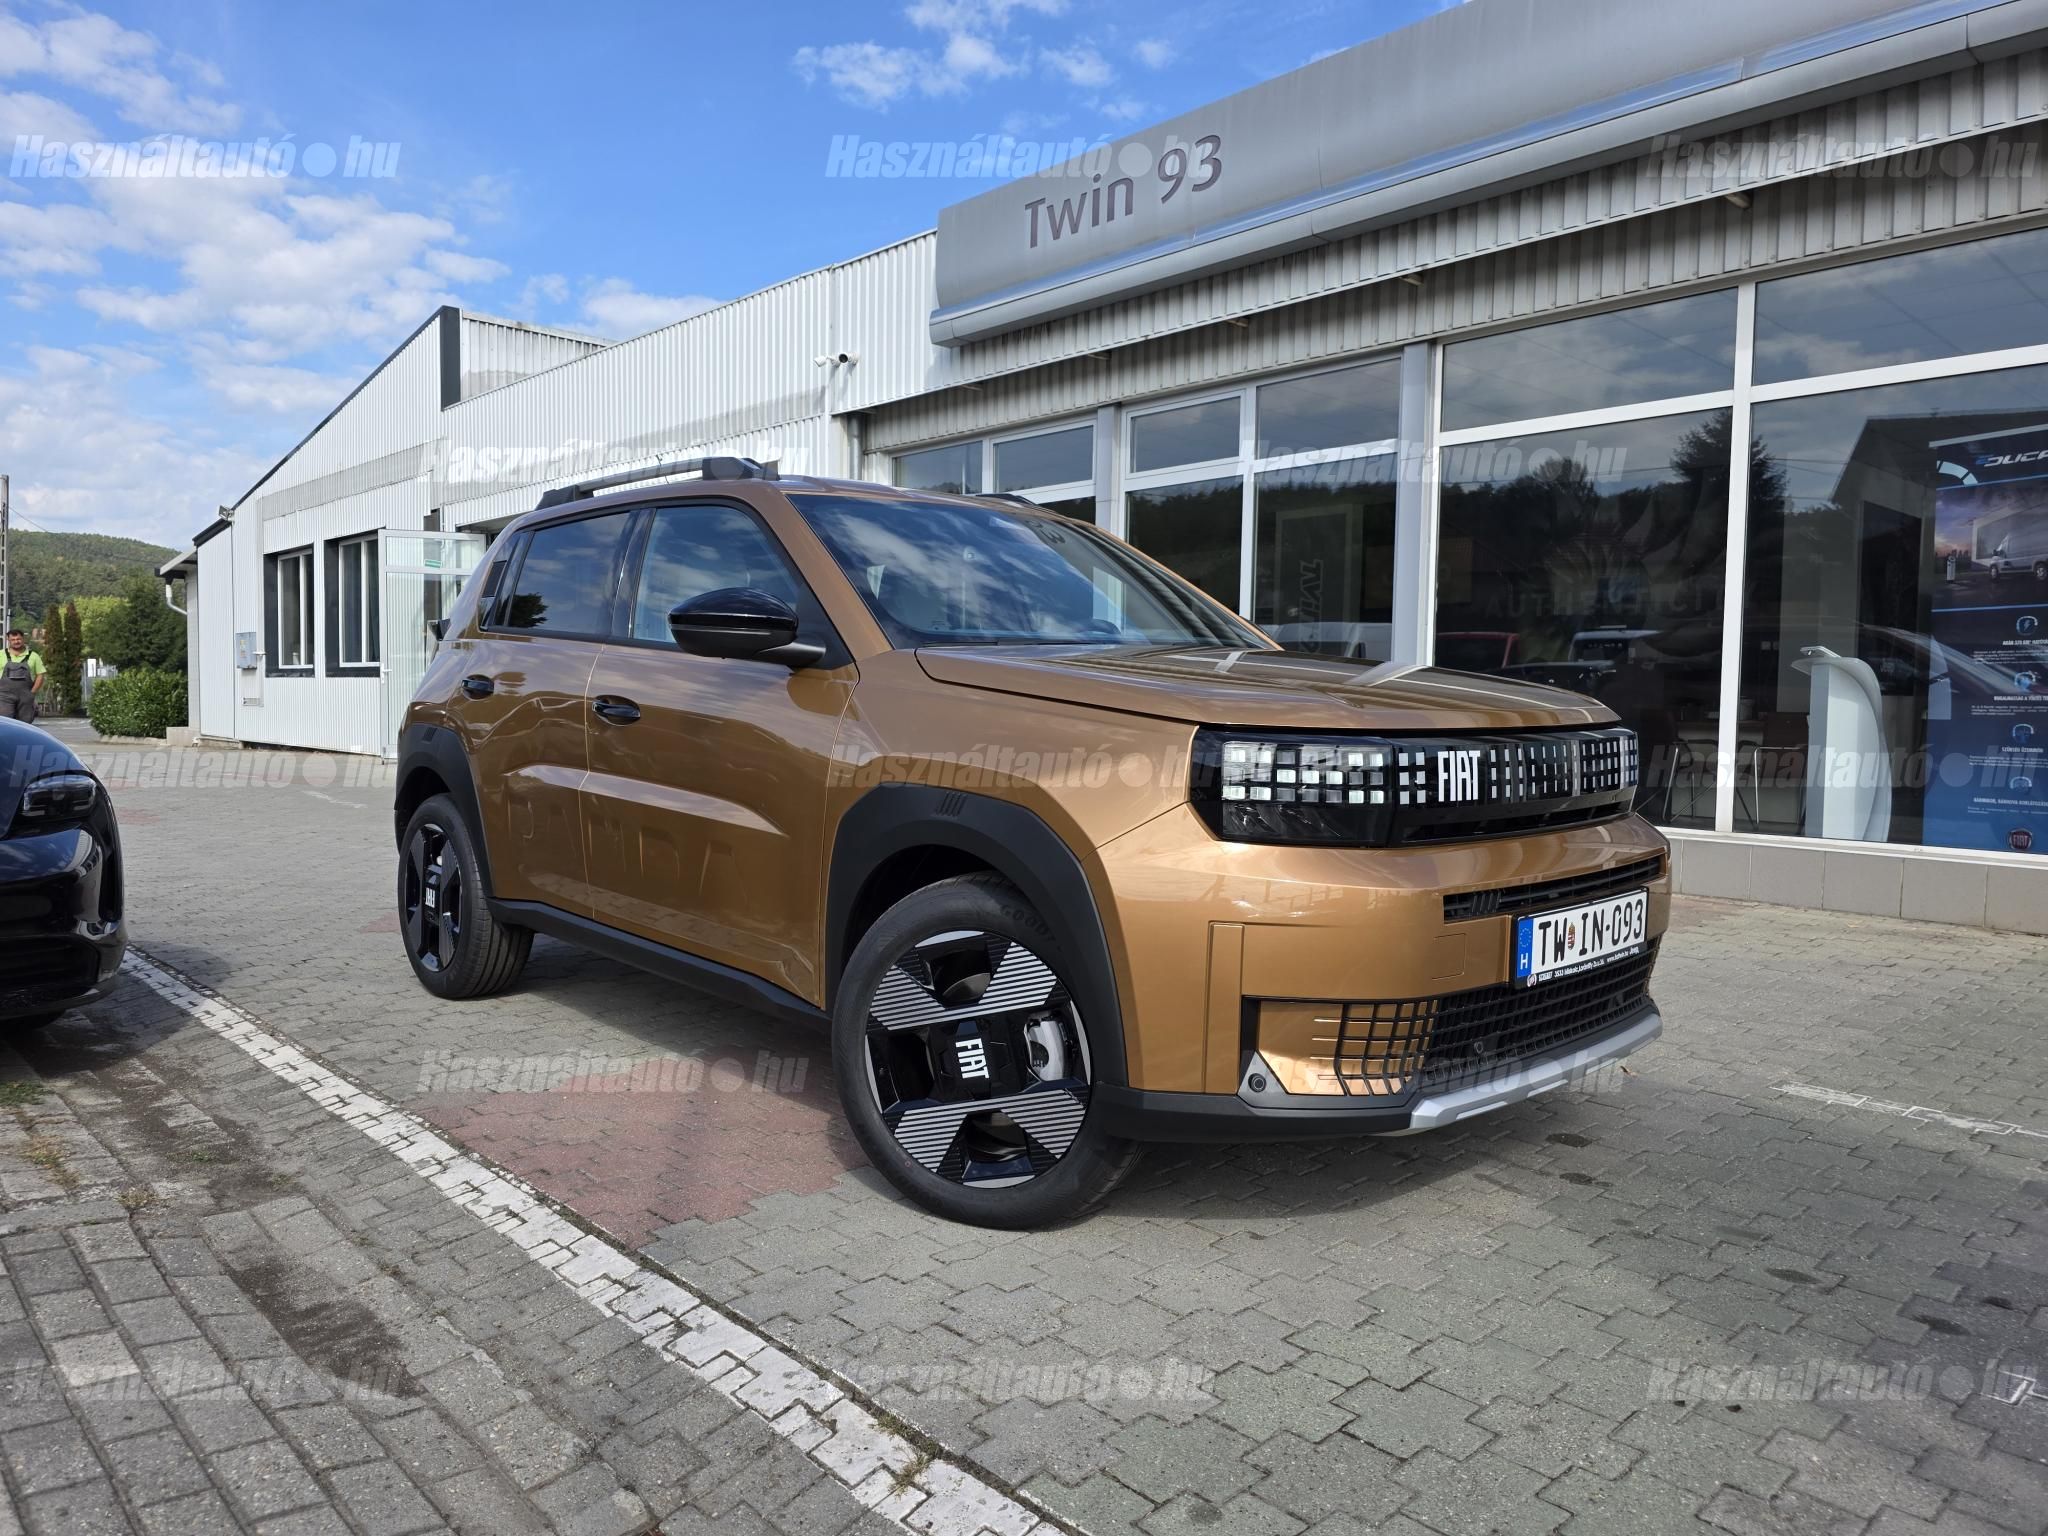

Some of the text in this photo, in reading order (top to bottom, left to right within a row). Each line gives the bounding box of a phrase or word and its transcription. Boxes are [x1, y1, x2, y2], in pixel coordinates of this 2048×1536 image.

[1024, 134, 1222, 248] Twin 93
[1437, 750, 1481, 802] FIAT
[2013, 834, 2029, 847] FIAT
[1538, 899, 1644, 966] TW IN-093
[1519, 952, 1529, 970] H
[955, 1037, 991, 1079] FIAT
